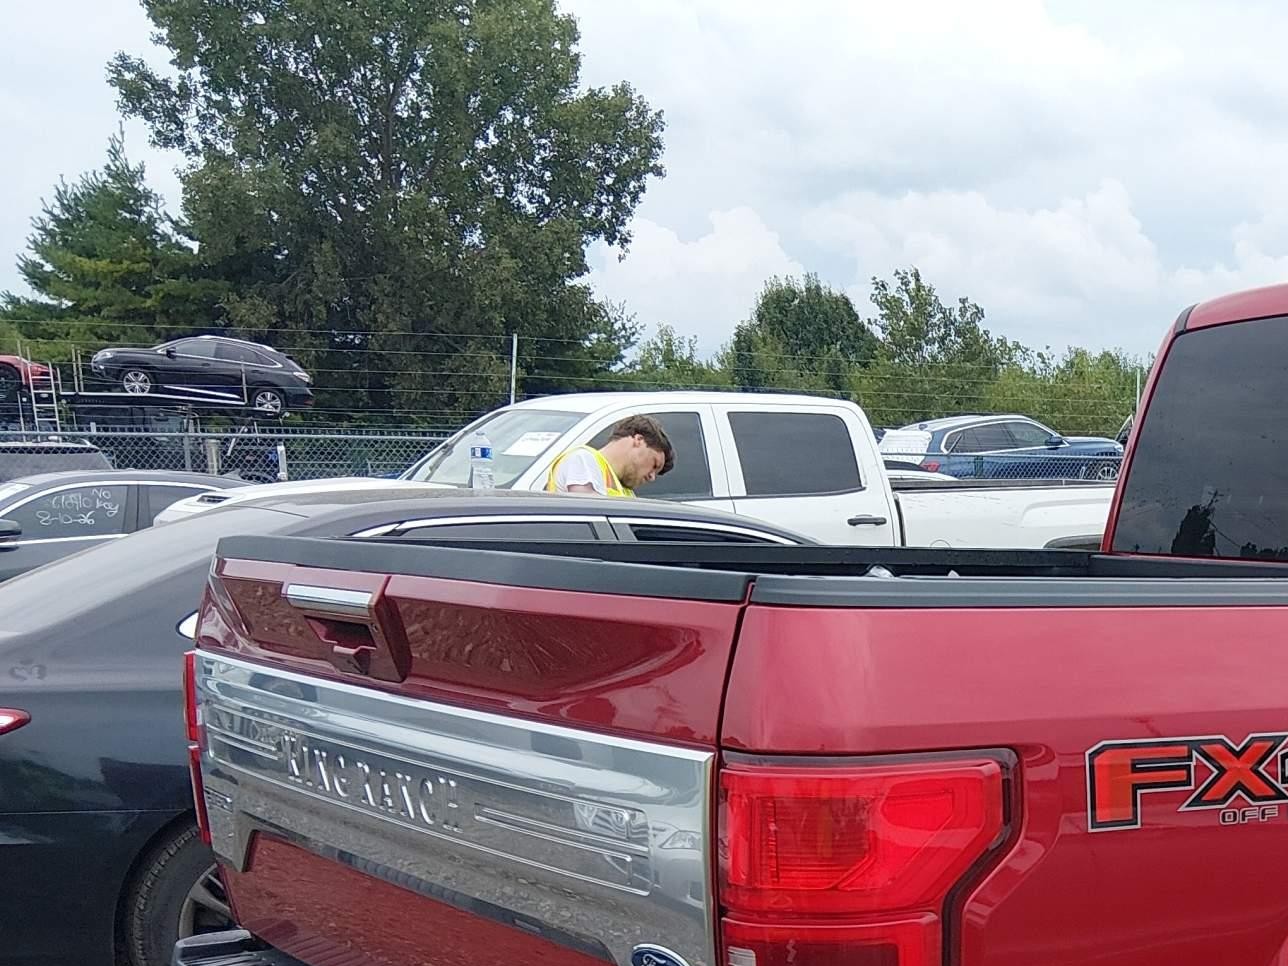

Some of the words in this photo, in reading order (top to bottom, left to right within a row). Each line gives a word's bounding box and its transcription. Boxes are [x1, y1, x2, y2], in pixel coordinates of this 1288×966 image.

[92, 488, 111, 499] No
[280, 729, 350, 798] KING
[355, 760, 464, 833] RANCH
[1220, 805, 1279, 825] OFF
